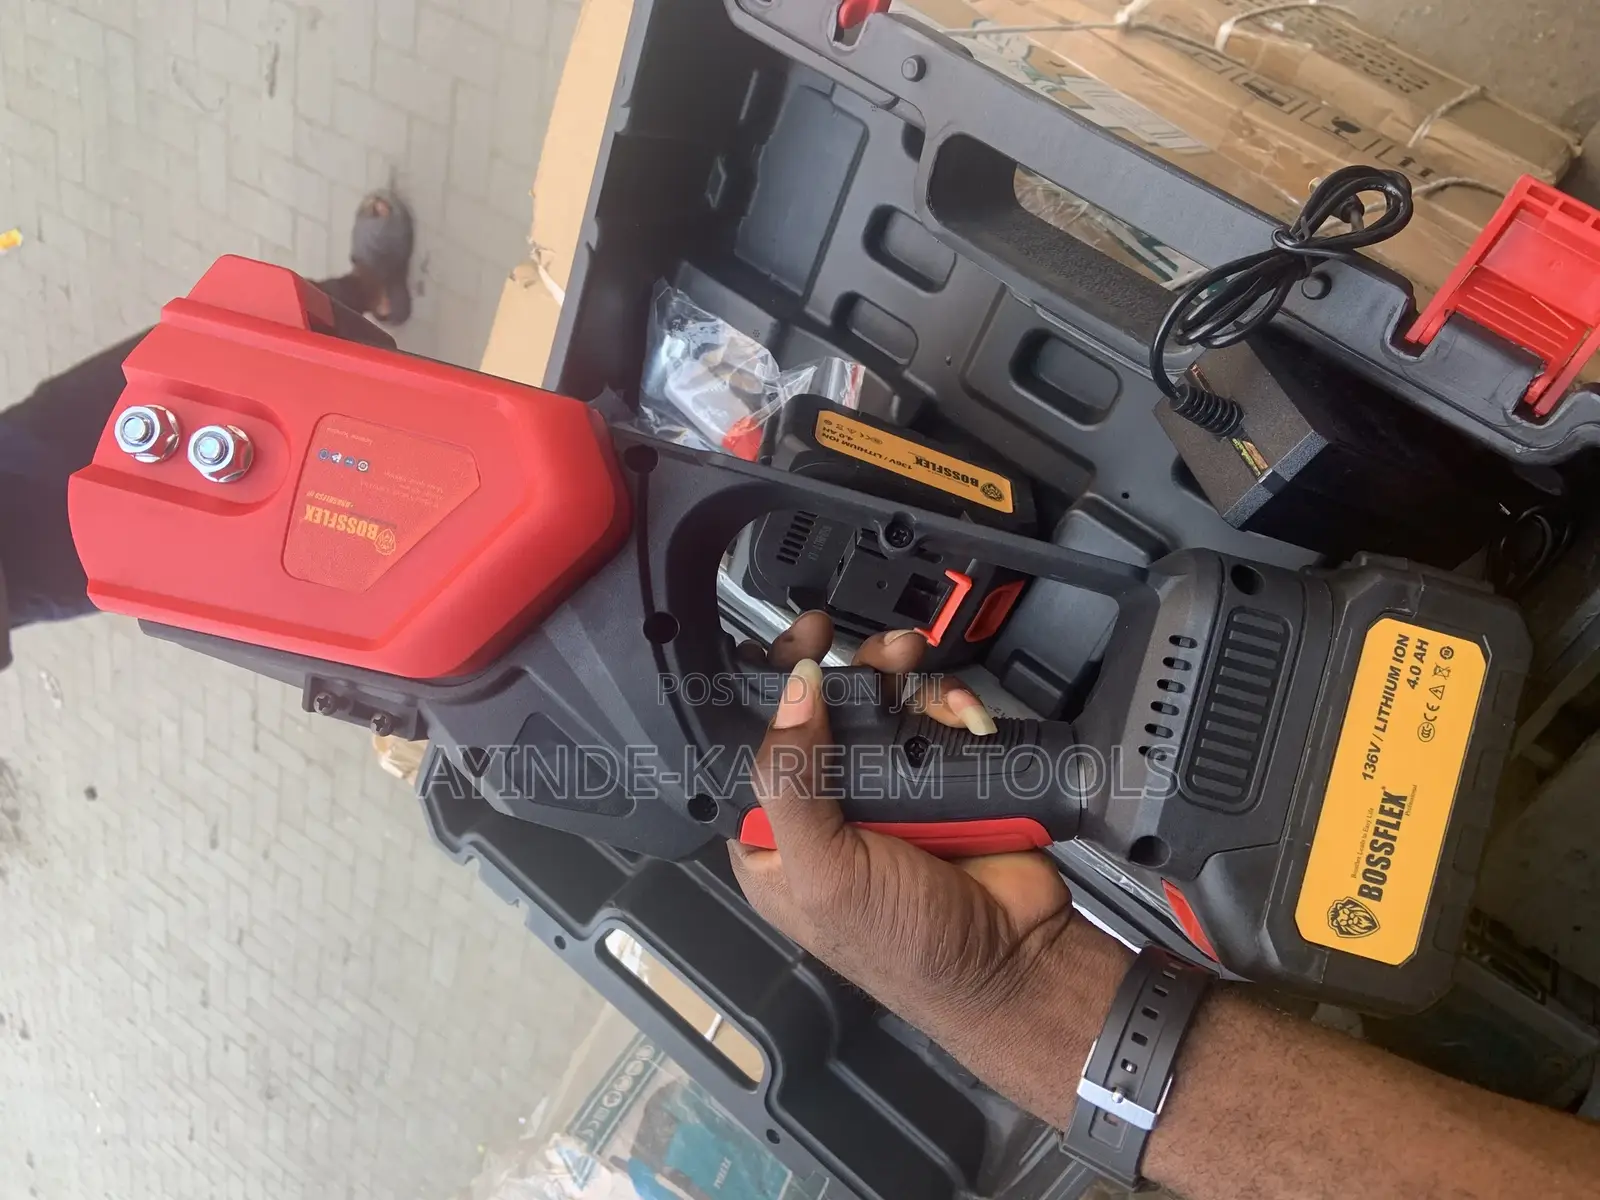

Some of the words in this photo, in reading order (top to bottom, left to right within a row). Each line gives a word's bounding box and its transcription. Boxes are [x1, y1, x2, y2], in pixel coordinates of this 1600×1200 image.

[822, 433, 839, 443] ION
[841, 440, 882, 458] LITHIUM
[888, 459, 912, 470] 136V
[914, 456, 979, 487] BOSSFLEX
[303, 504, 379, 541] BOSSFLEX
[1414, 638, 1429, 664] AH
[1407, 664, 1422, 690] 4.0
[1362, 741, 1382, 782] 136V
[1374, 665, 1401, 733] LITHIUM
[1392, 634, 1409, 664] ION
[1357, 791, 1407, 902] BOSSFLEX
